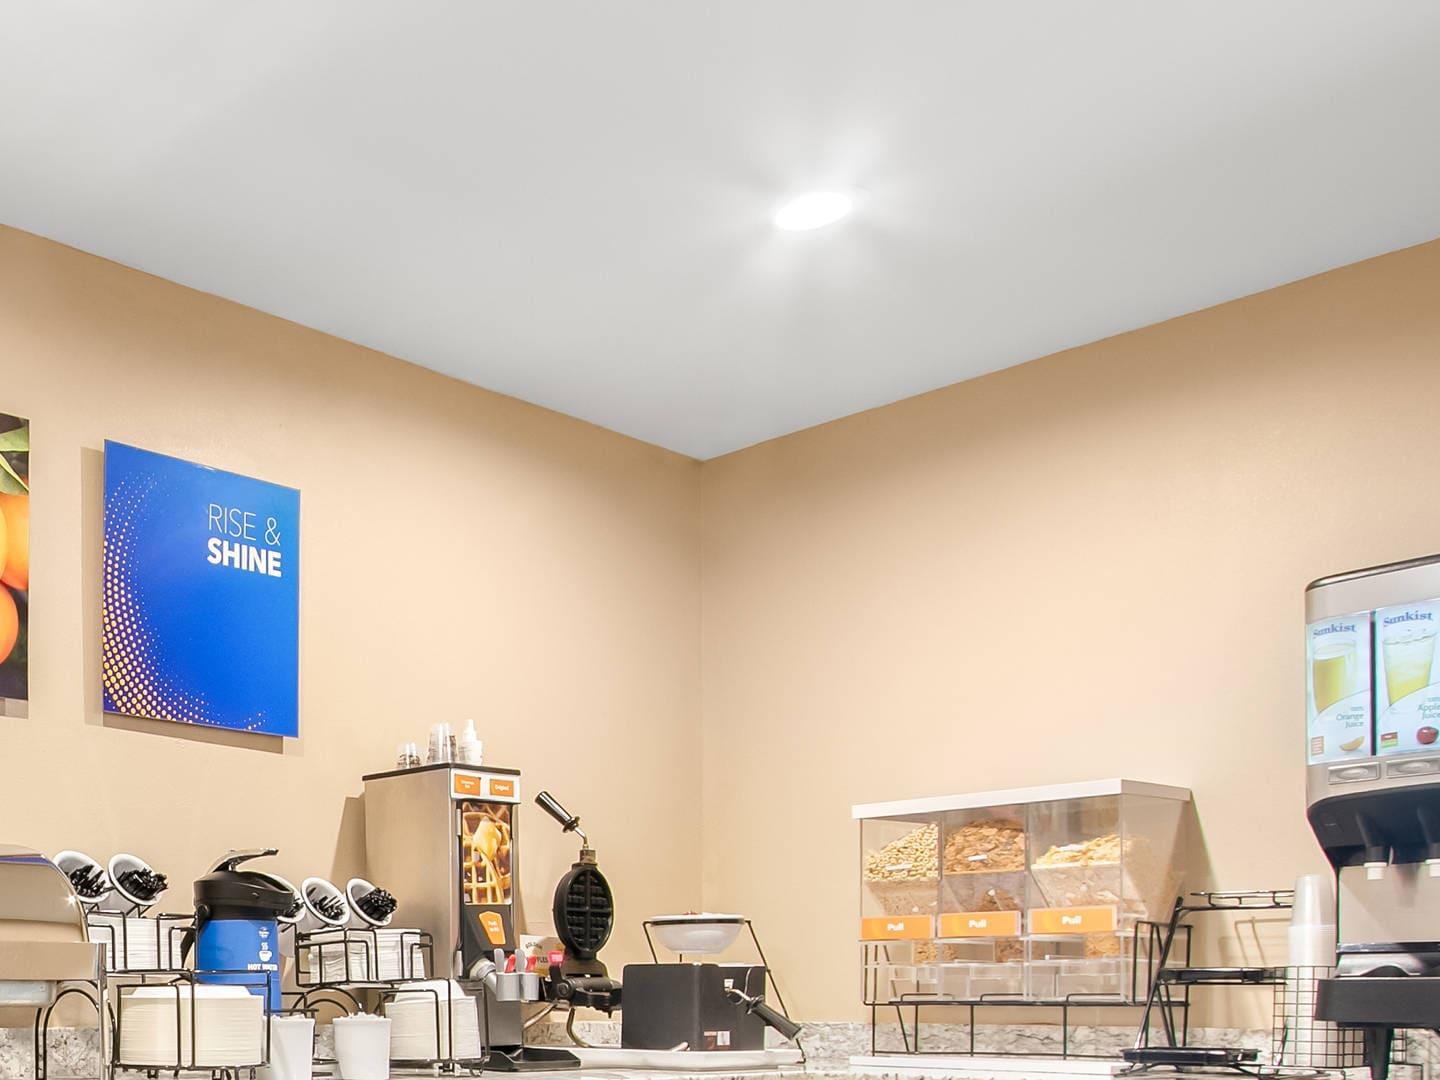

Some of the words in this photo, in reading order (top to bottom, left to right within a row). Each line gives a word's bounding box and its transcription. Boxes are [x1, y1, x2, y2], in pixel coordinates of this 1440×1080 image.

[208, 503, 257, 541] RISE
[264, 517, 281, 546] &
[207, 537, 282, 578] SHINE
[1383, 610, 1433, 627] Sunkist
[1313, 623, 1357, 638] Sunkist
[1336, 713, 1364, 722] Orange
[968, 919, 987, 928] Pull
[1061, 915, 1082, 925] Pull
[887, 922, 904, 931] Pull
